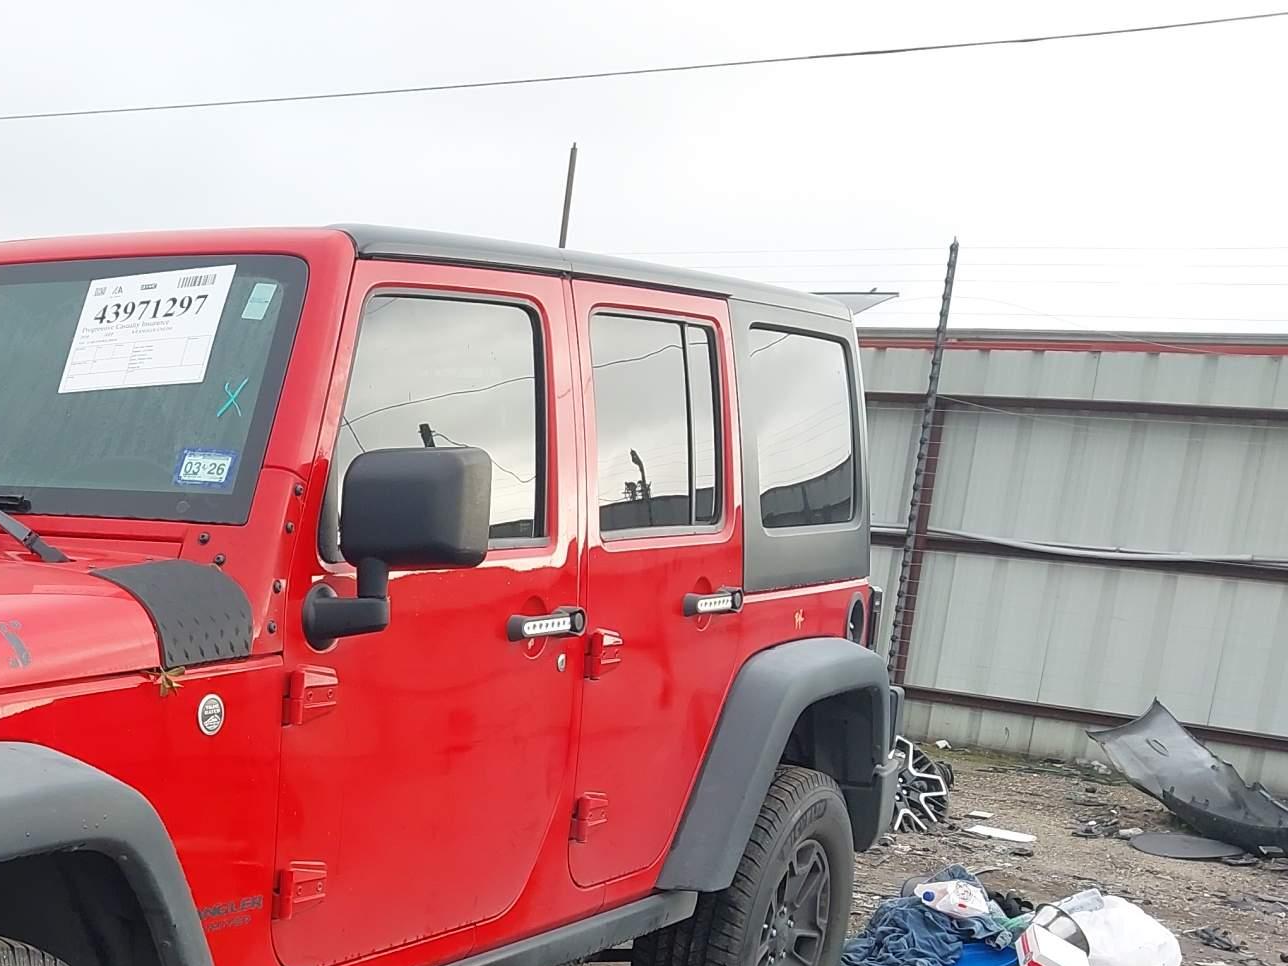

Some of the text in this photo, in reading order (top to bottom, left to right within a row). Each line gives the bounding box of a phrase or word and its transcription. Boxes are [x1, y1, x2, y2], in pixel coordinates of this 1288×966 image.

[93, 294, 209, 324] 43971297
[183, 461, 226, 476] 03 26
